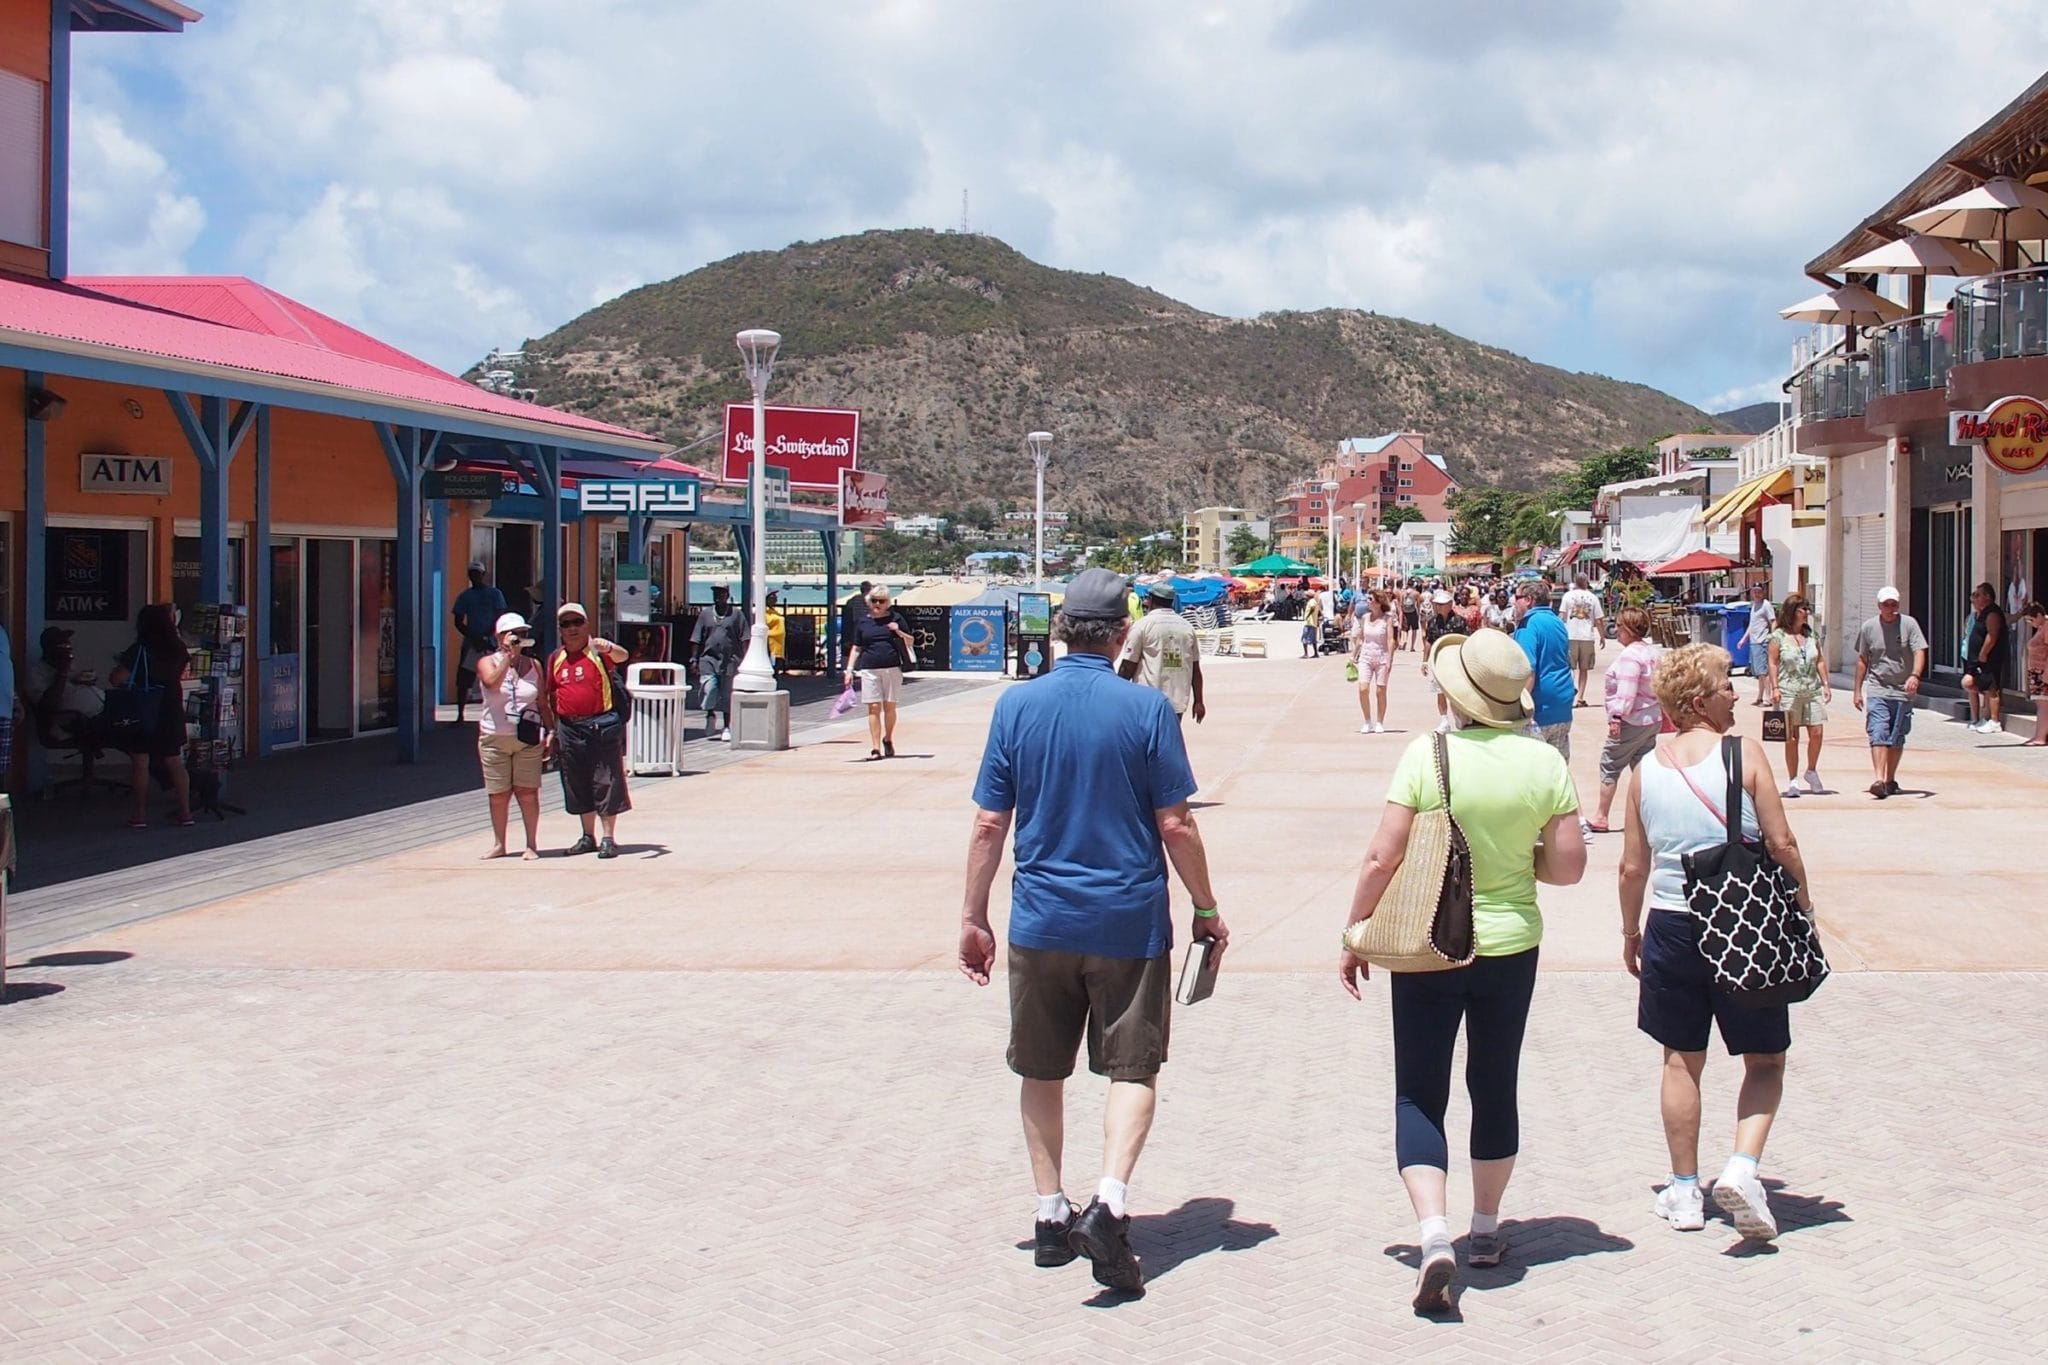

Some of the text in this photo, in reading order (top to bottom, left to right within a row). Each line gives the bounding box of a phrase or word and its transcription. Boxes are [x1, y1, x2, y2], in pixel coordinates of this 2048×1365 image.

[1957, 413, 2020, 439] Hard
[765, 435, 851, 459] Switzerland
[92, 459, 162, 482] ATM
[580, 484, 695, 511] EFFY
[68, 568, 97, 579] RBC
[56, 596, 93, 611] ATM
[954, 609, 971, 617] ALEX
[972, 609, 988, 617] AND
